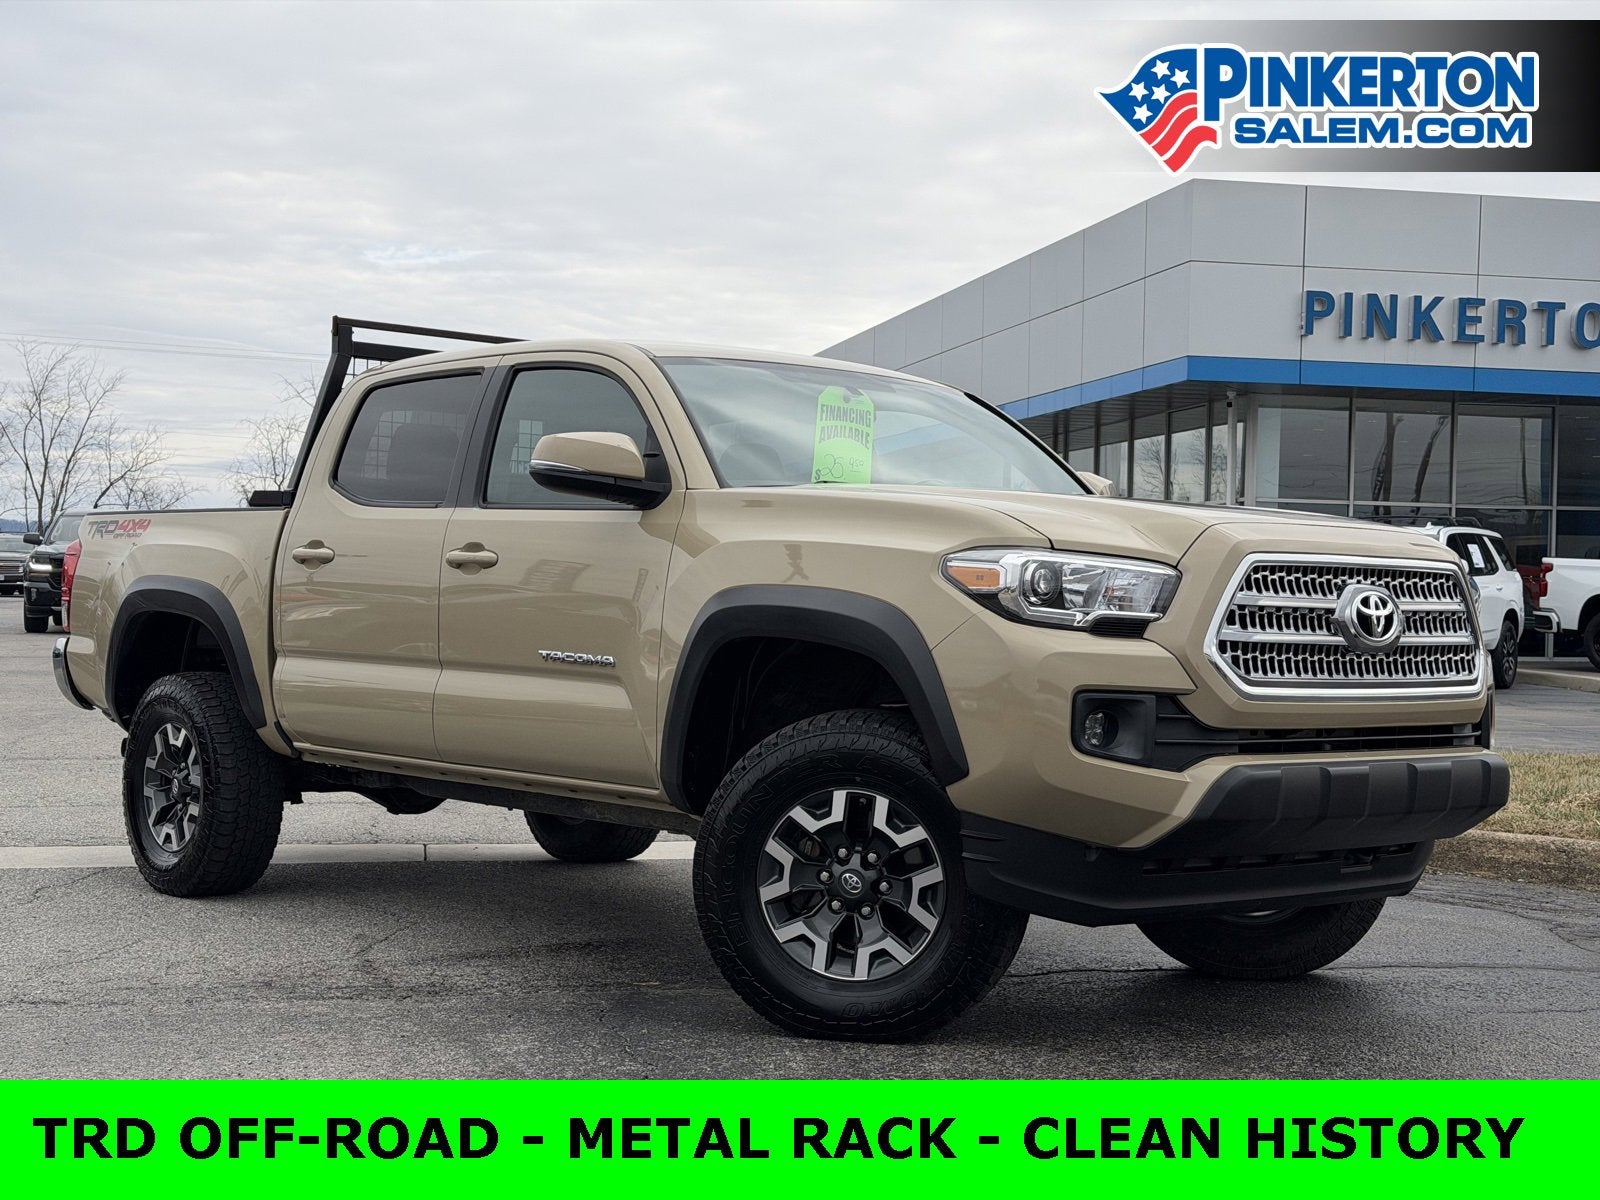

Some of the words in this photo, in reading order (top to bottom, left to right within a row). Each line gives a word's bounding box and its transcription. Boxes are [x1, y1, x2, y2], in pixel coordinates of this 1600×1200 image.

[1301, 290, 1600, 350] PINKERTO
[819, 404, 871, 428] FINANCING
[818, 425, 870, 450] AVAILABLE
[538, 649, 616, 667] TACOMA
